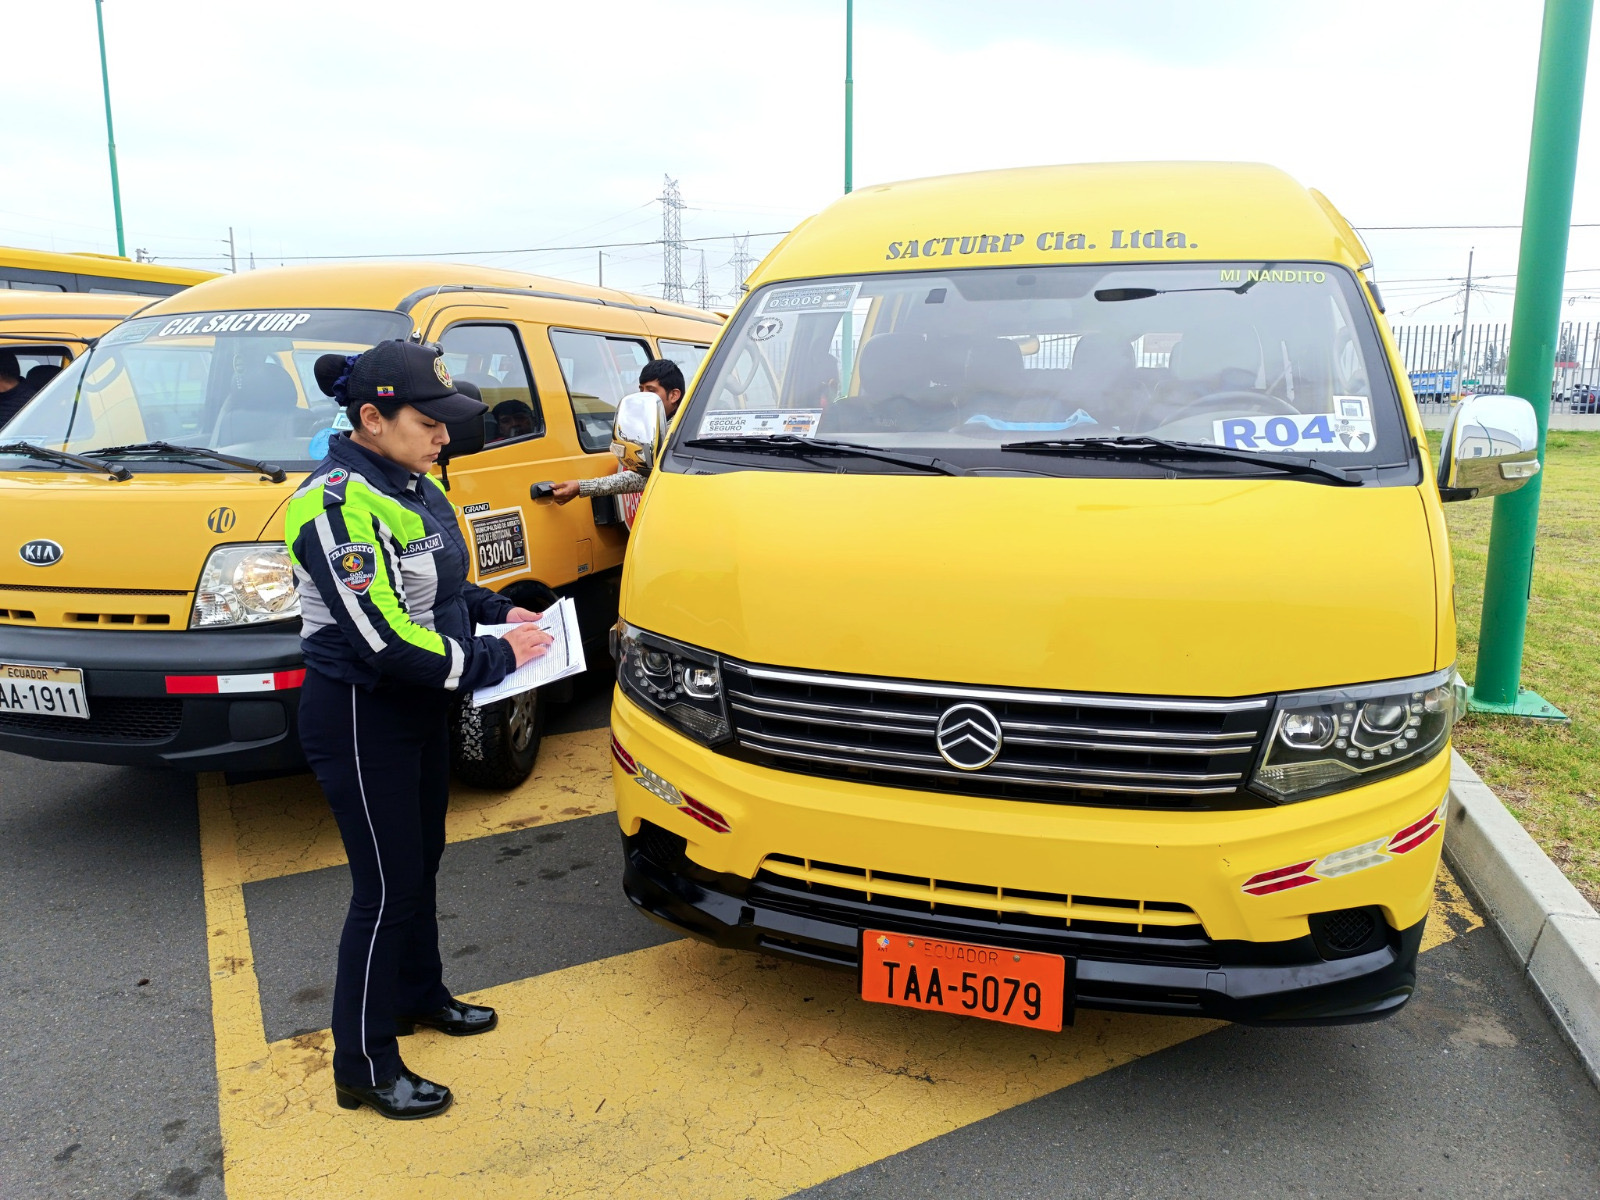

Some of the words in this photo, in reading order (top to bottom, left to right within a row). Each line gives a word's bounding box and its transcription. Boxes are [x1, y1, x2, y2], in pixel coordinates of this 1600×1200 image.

[885, 233, 1025, 260] SACTURP
[1036, 231, 1097, 251] Cia.
[1110, 229, 1199, 249] Ltda.
[1220, 269, 1241, 281] MI
[1247, 269, 1326, 283] NANDITO
[769, 295, 822, 308] 03008
[1222, 415, 1336, 450] R-04
[210, 508, 234, 532] 10
[464, 504, 489, 514] GRAND
[25, 544, 55, 560] KIA
[479, 539, 513, 568] 03010
[7, 667, 48, 680] ECUADOR
[924, 942, 999, 965] ECUADOR
[882, 961, 1041, 1021] TAA-5079
